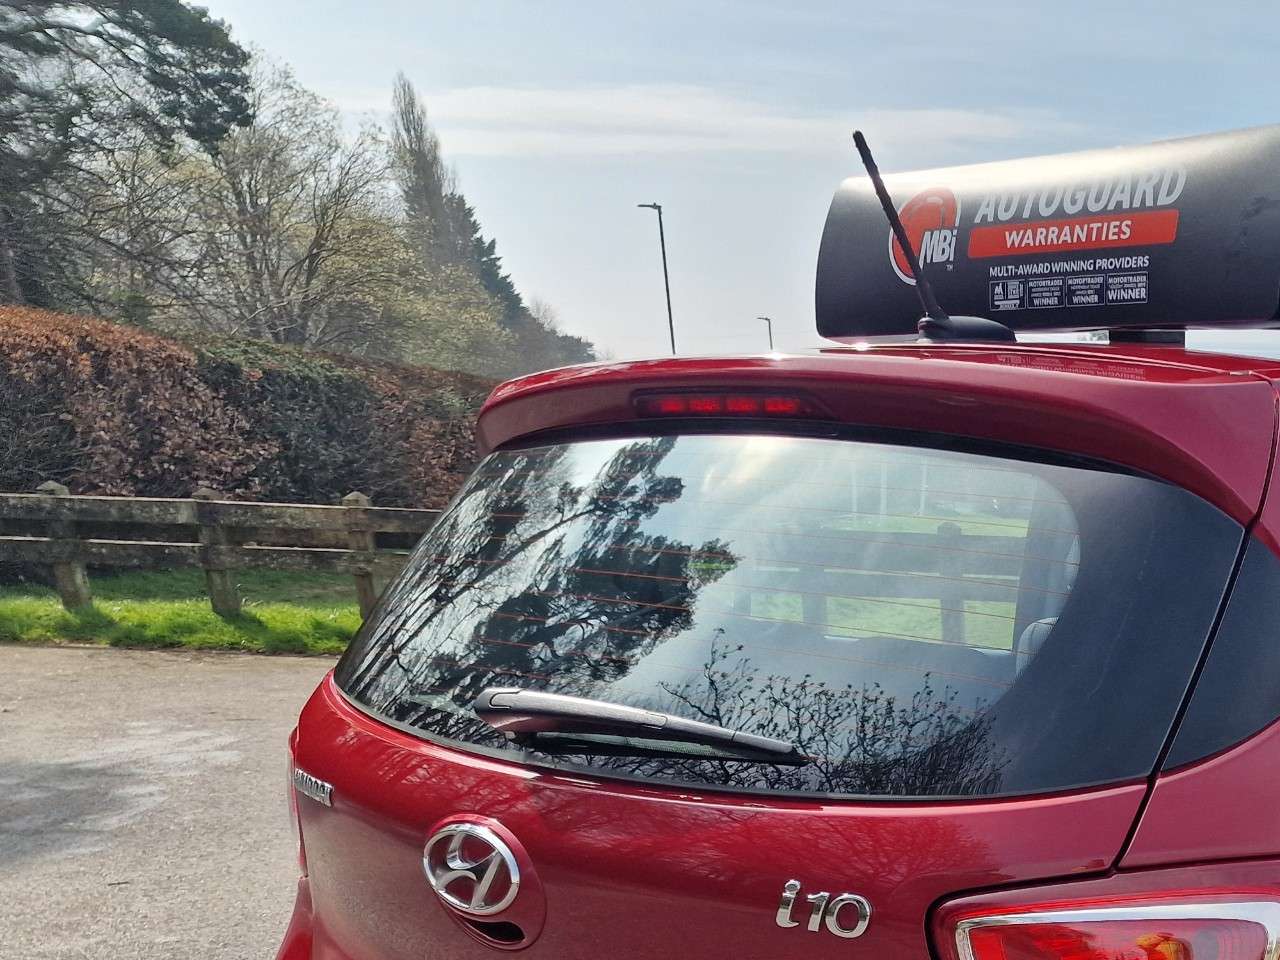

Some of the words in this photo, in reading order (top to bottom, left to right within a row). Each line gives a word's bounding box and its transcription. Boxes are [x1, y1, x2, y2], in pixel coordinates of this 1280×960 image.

[974, 167, 1186, 224] AUTOGUARD
[1004, 220, 1132, 249] WARRANTIES
[989, 263, 1051, 278] MULTI-AWARD
[1051, 259, 1094, 273] WINNING
[1095, 255, 1150, 271] PROVIDERS
[1033, 297, 1059, 307] WINNER
[1072, 294, 1099, 305] WINNER
[1107, 288, 1147, 301] WINNER
